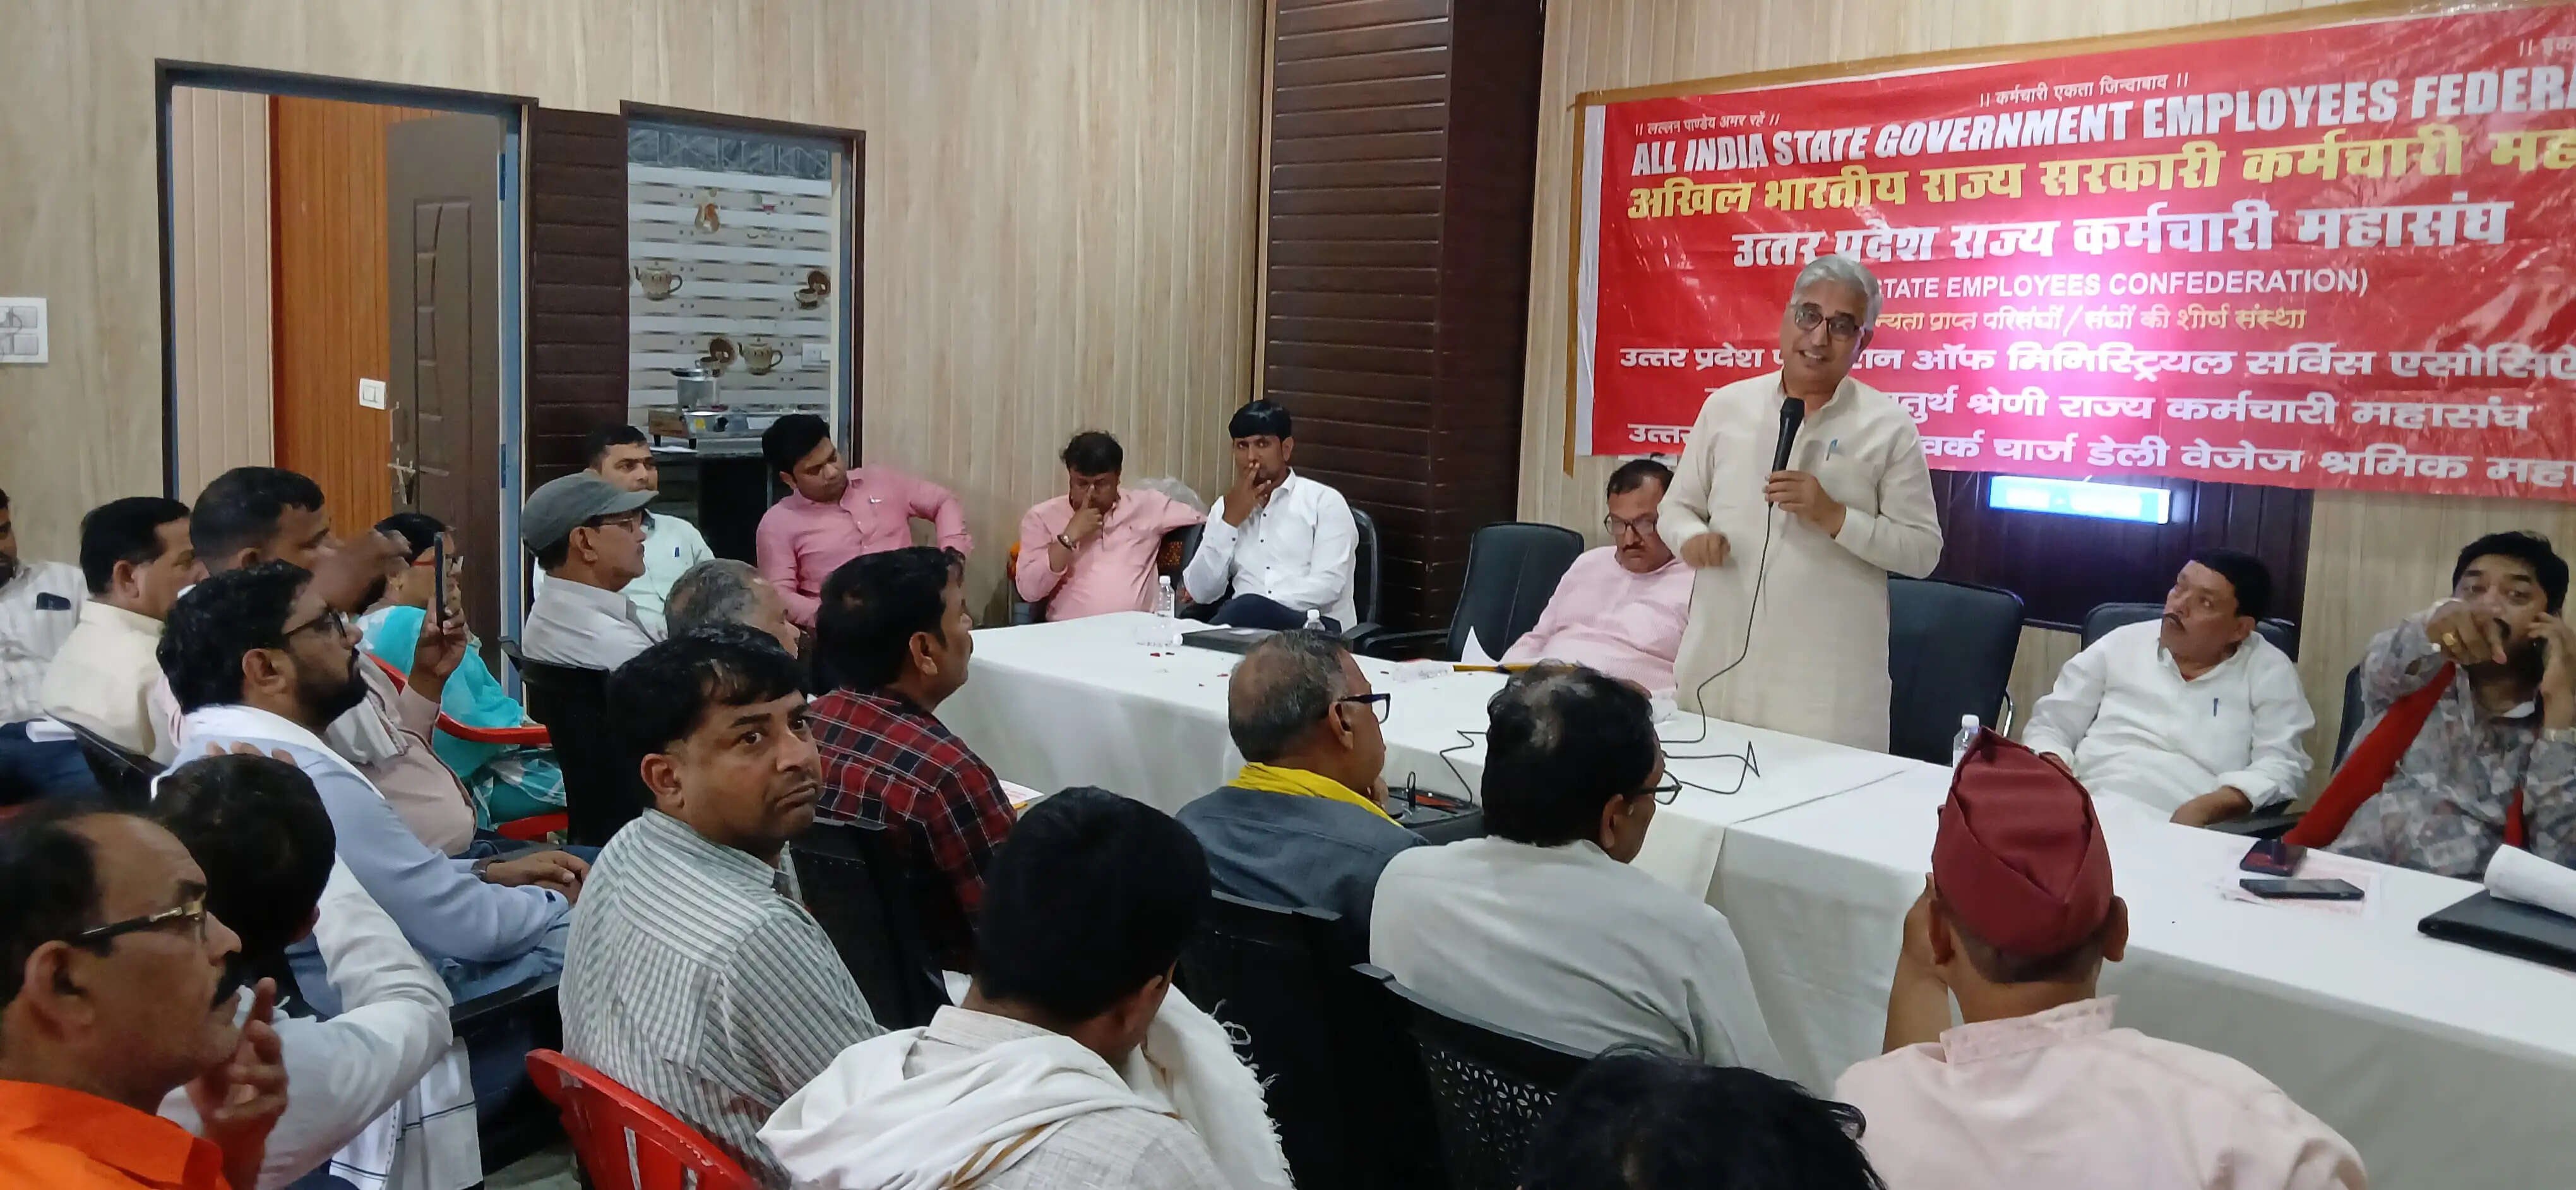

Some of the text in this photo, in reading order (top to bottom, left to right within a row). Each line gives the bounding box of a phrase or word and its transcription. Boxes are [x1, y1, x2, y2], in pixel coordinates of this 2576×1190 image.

[1631, 140, 1677, 176] ALL
[1684, 133, 1769, 172] INDIA
[1773, 126, 1871, 166] STATE
[1874, 101, 2133, 157] GOVERNMENT
[2143, 79, 2400, 139] EMPLOYEES
[1627, 177, 1757, 219] अखिल
[1763, 165, 1909, 212] भारतीय
[1919, 162, 2027, 203] राज्य
[2038, 140, 2227, 197] सरकारी
[2242, 123, 2466, 184] कर्मचारी
[1950, 221, 2061, 260] राज्य
[2072, 199, 2279, 255] कर्मचारी
[2296, 191, 2515, 249] महासंघ
[1876, 268, 2369, 299] TATE EMPLOYEES CONFEDERATION)
[1874, 312, 1924, 332] न्यता
[2140, 304, 2171, 329] की
[2235, 303, 2307, 330] संस्था
[1619, 348, 1690, 368] उत्तर
[1693, 342, 1765, 371] प्रदेश
[1911, 343, 1997, 371] ऑफ
[2245, 342, 2377, 375] सर्विस
[1891, 385, 2534, 430] तुर्थ श्रेणी राज्य कर्मचारी महासंघ
[1993, 433, 2078, 462] चार्ज
[2087, 435, 2170, 468] डेली
[2181, 438, 2305, 472] वेजेज
[2318, 443, 2474, 479] श्रमिक
[2486, 457, 2576, 487] मह
